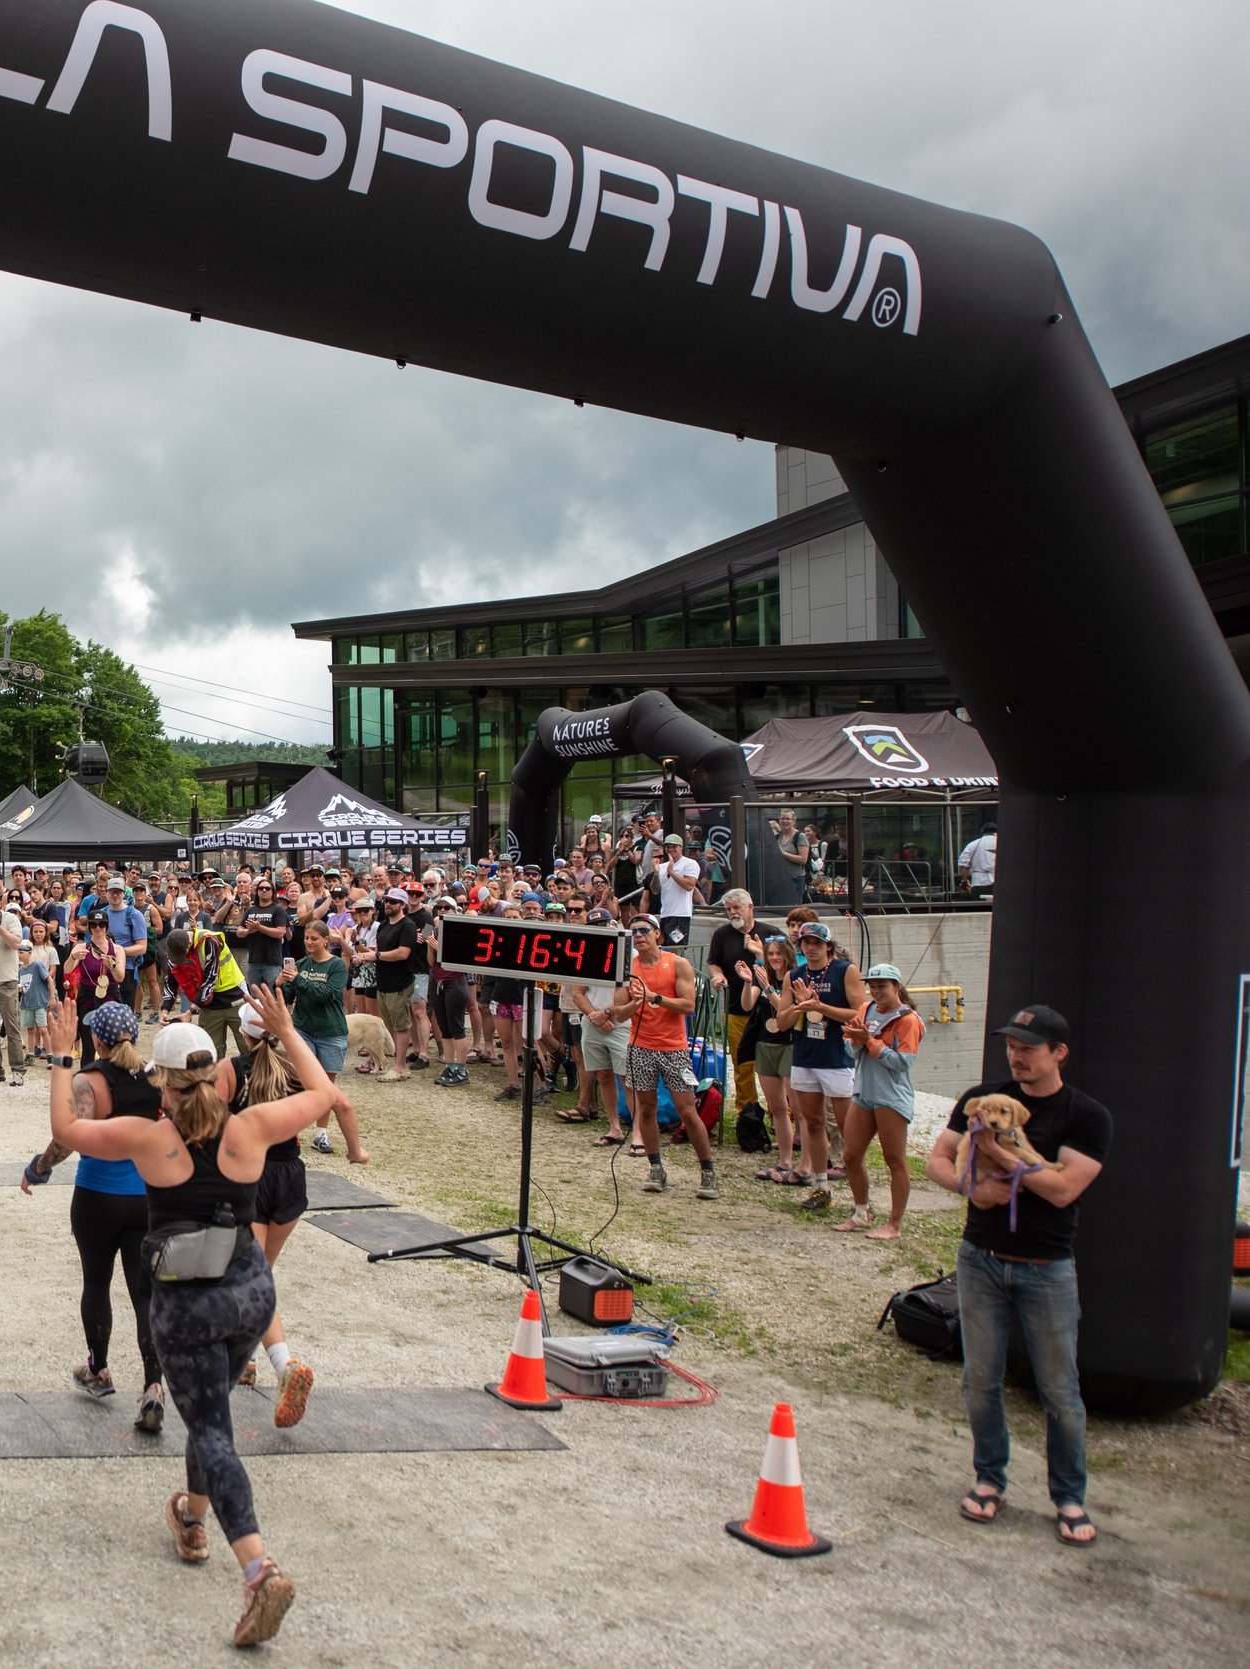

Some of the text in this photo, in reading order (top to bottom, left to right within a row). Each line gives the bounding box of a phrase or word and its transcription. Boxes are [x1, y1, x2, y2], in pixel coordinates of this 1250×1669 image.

[227, 48, 922, 336] SPORTIVA
[552, 717, 610, 741] NATURES
[554, 738, 619, 757] SUNSHINE
[870, 777, 929, 788] FOOD
[949, 776, 998, 786] DRIN
[193, 831, 270, 849] CIRQUE SERIES
[278, 829, 466, 849] CIRQUE SERIES
[474, 928, 614, 974] 3:16:41
